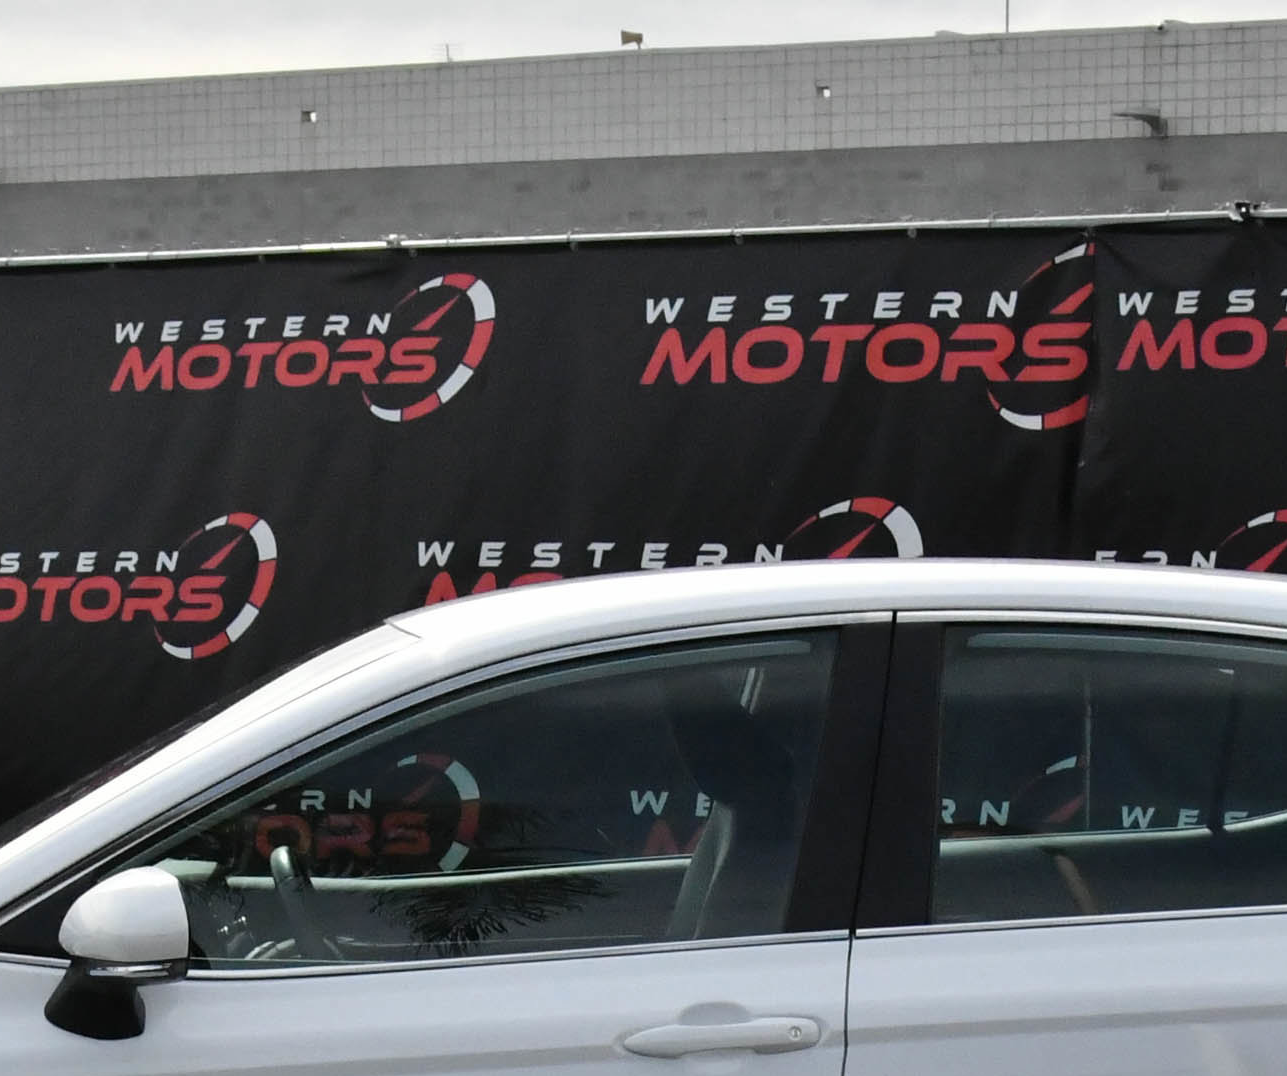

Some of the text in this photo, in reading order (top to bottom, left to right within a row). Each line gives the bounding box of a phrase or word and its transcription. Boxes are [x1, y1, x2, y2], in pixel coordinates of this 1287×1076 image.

[646, 290, 1018, 325] WESTERN
[115, 312, 392, 344] WESTERN
[109, 335, 441, 393] MOTORS
[641, 321, 1091, 385] MOTORS
[417, 540, 785, 569] WESTERN
